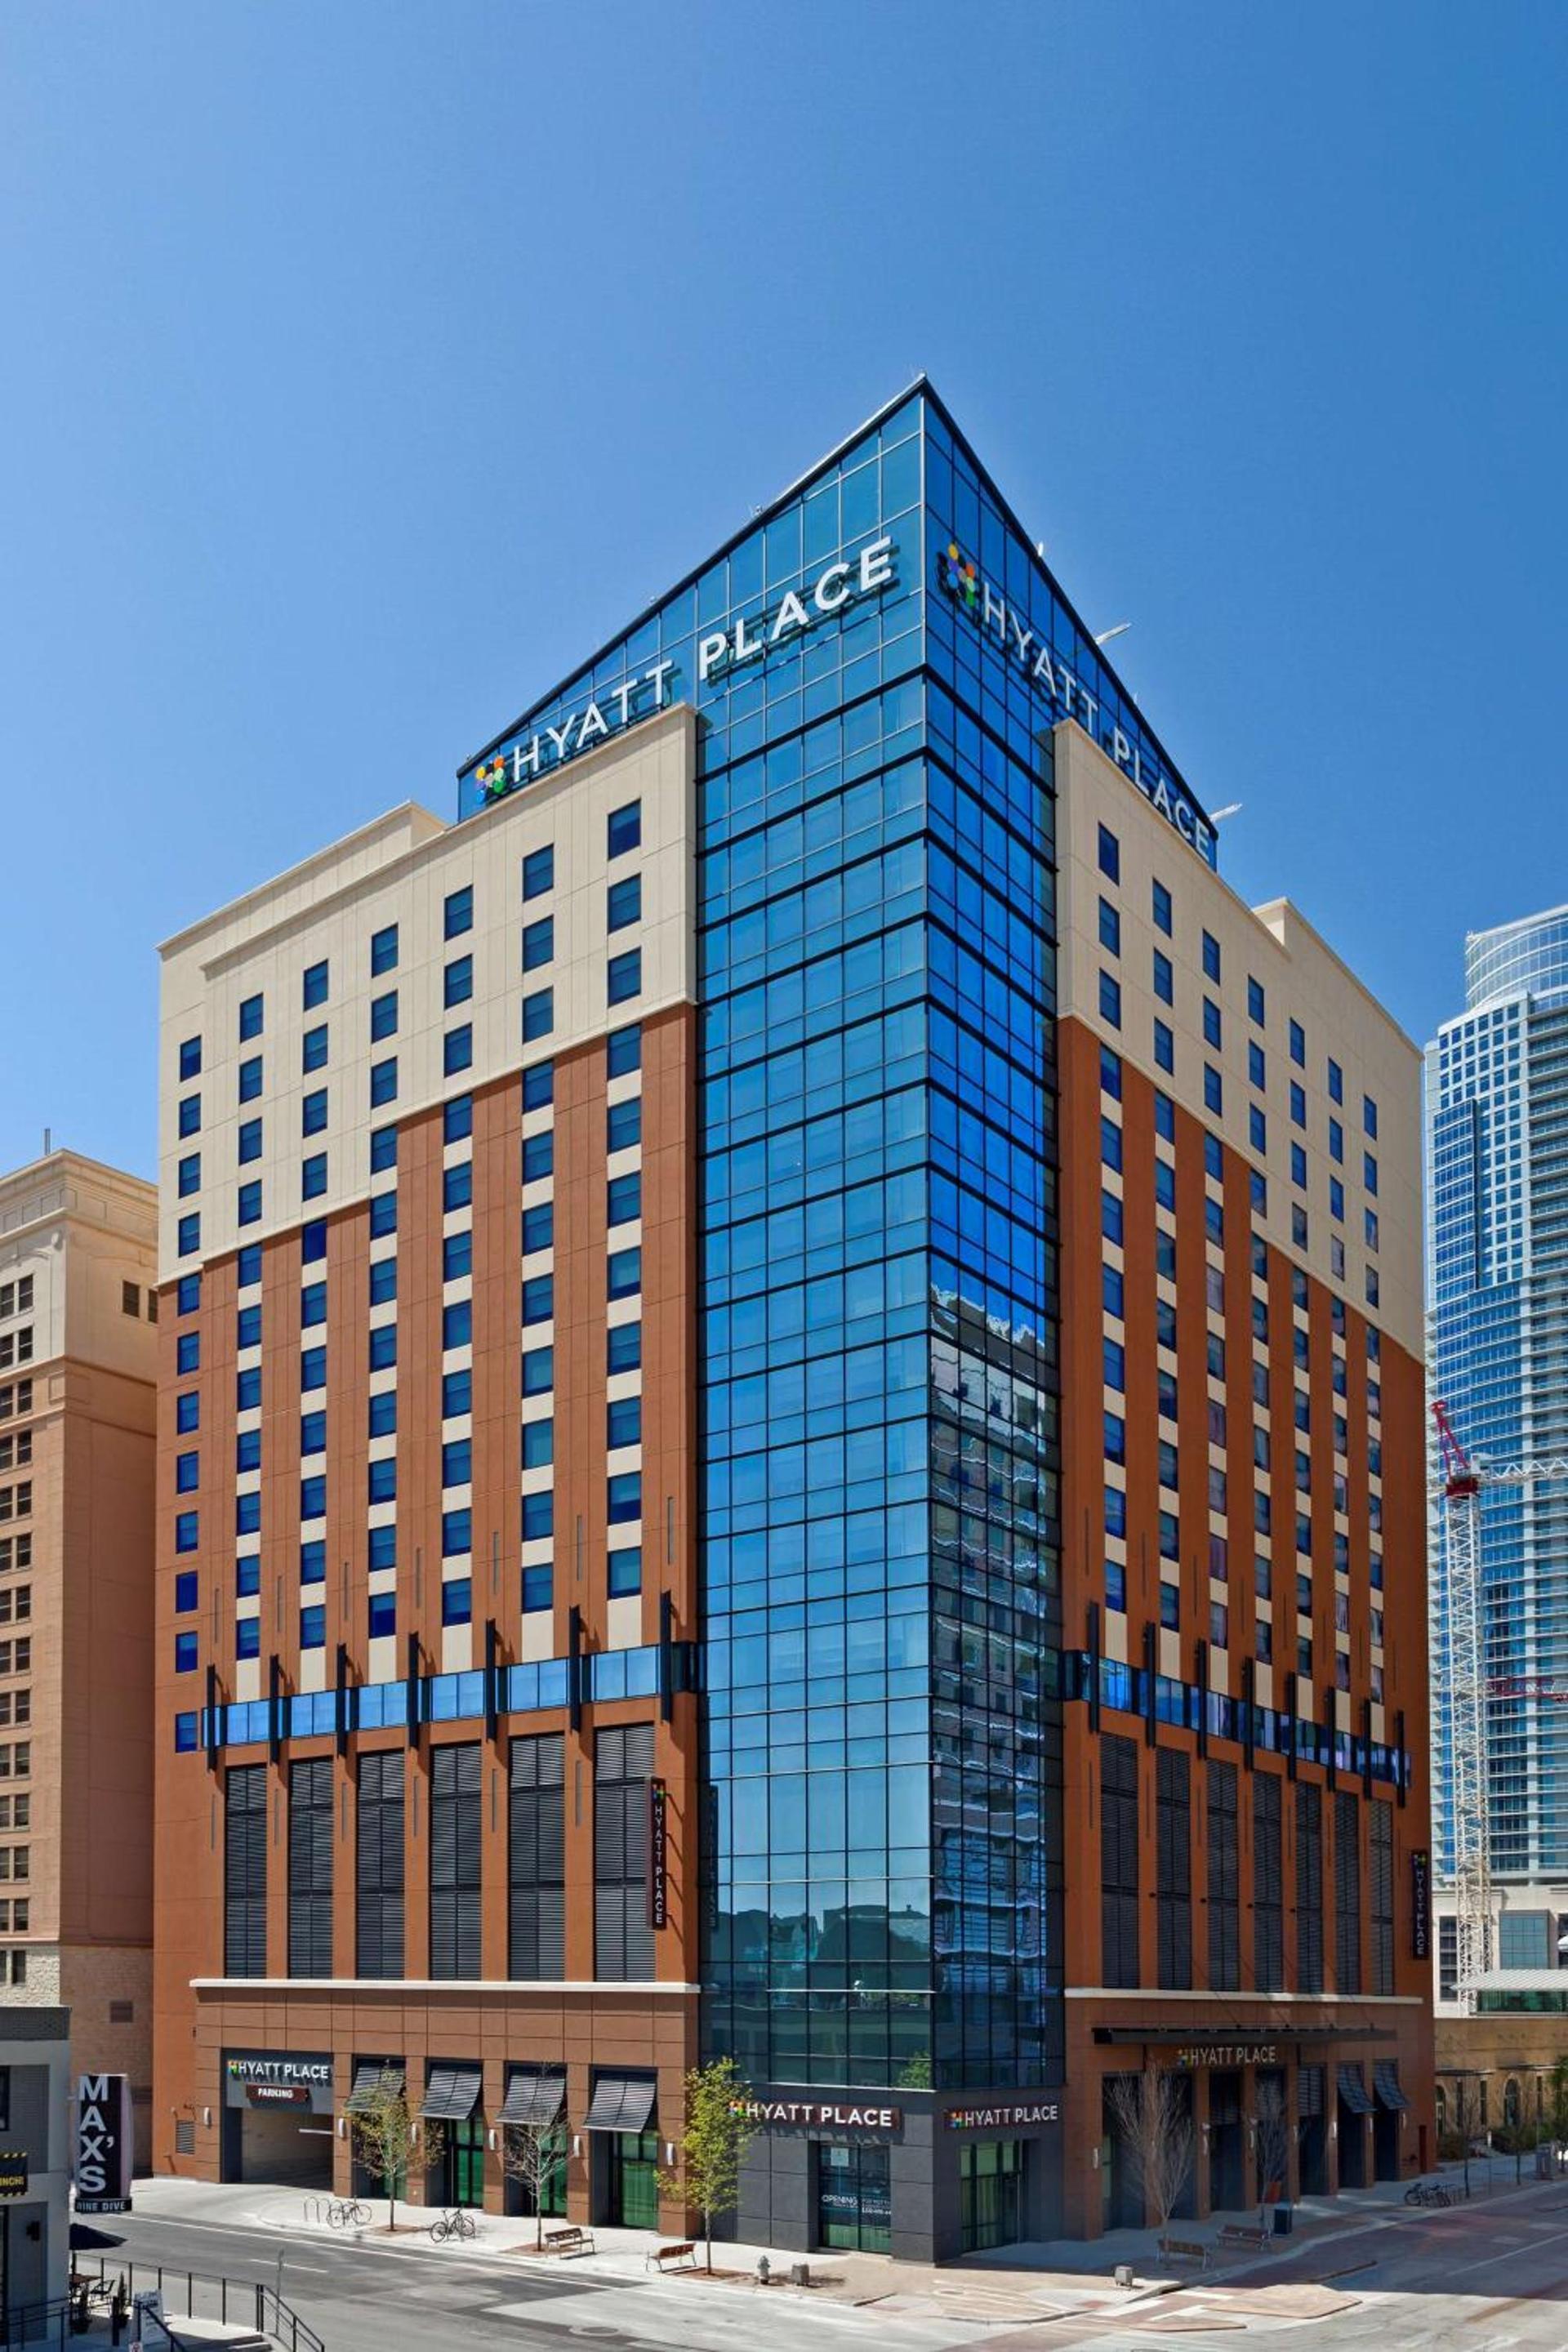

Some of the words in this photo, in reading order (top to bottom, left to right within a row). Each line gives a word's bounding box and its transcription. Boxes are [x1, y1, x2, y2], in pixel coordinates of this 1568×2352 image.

[513, 659, 674, 782] HYATT
[699, 536, 893, 681] PLACE
[983, 581, 1098, 735] HYATT
[1113, 725, 1210, 862] PLACE
[654, 1806, 663, 1862] HYATT
[655, 1867, 663, 1923] PLACE
[1416, 1870, 1424, 1909] HYATT
[1417, 1913, 1425, 1955] PLACE
[238, 2061, 280, 2076] HYATT
[283, 2064, 328, 2079] PLACE
[1191, 2046, 1232, 2066] HYATT
[1236, 2045, 1276, 2065] PLACE
[257, 2087, 294, 2099] PARKING
[746, 2101, 813, 2122] HYATT
[821, 2106, 892, 2127] PLACE
[964, 2108, 1011, 2127] HYATT
[1015, 2105, 1058, 2123] PLACE
[78, 2075, 114, 2194] MAX'S
[102, 2201, 127, 2212] DIVE
